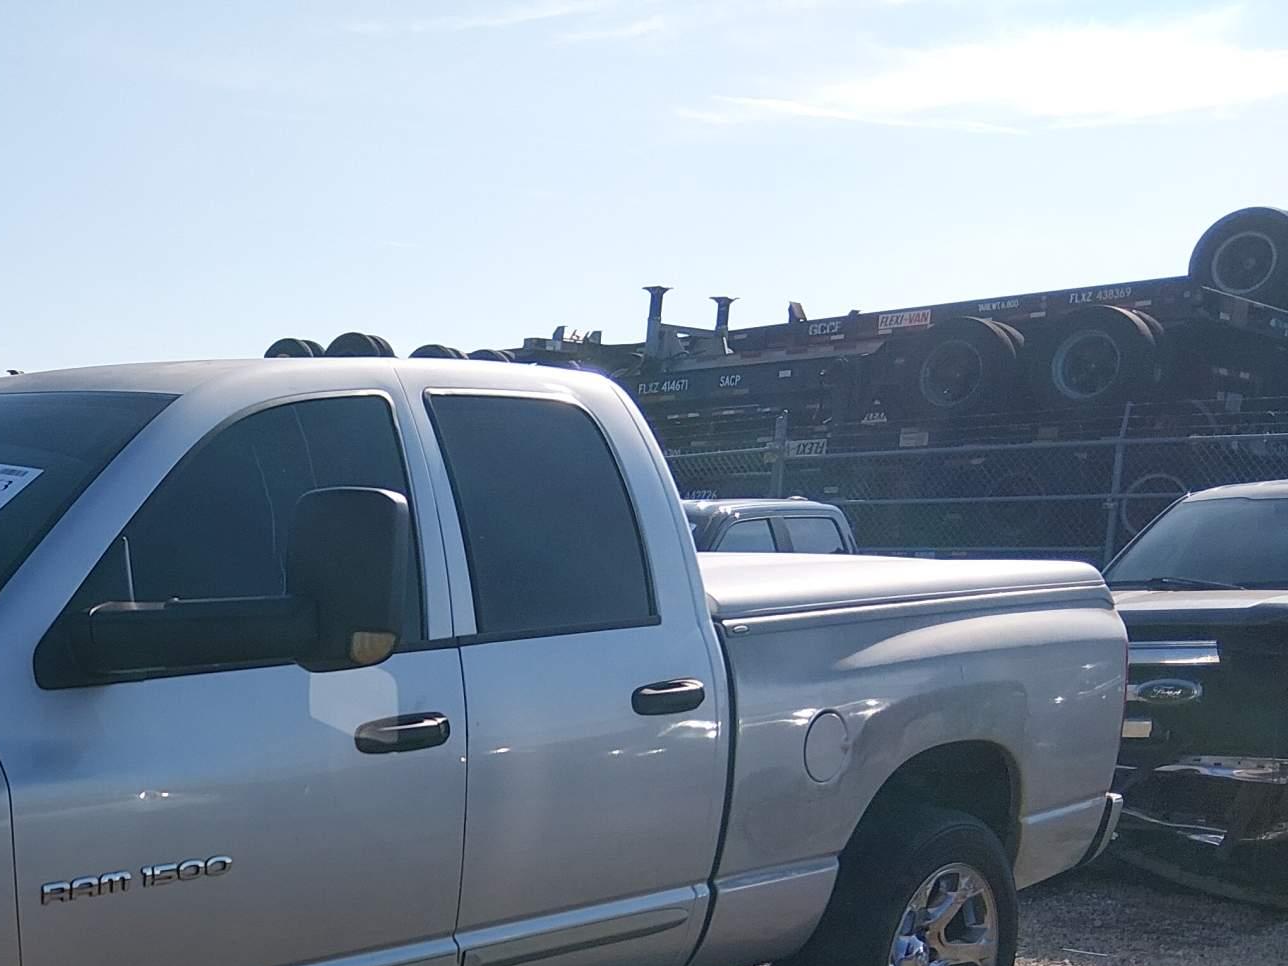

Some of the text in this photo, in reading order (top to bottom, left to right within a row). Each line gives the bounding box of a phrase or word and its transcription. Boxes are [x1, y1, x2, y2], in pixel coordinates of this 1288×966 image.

[719, 374, 741, 388] SACP
[40, 854, 233, 906] RAM 1500
